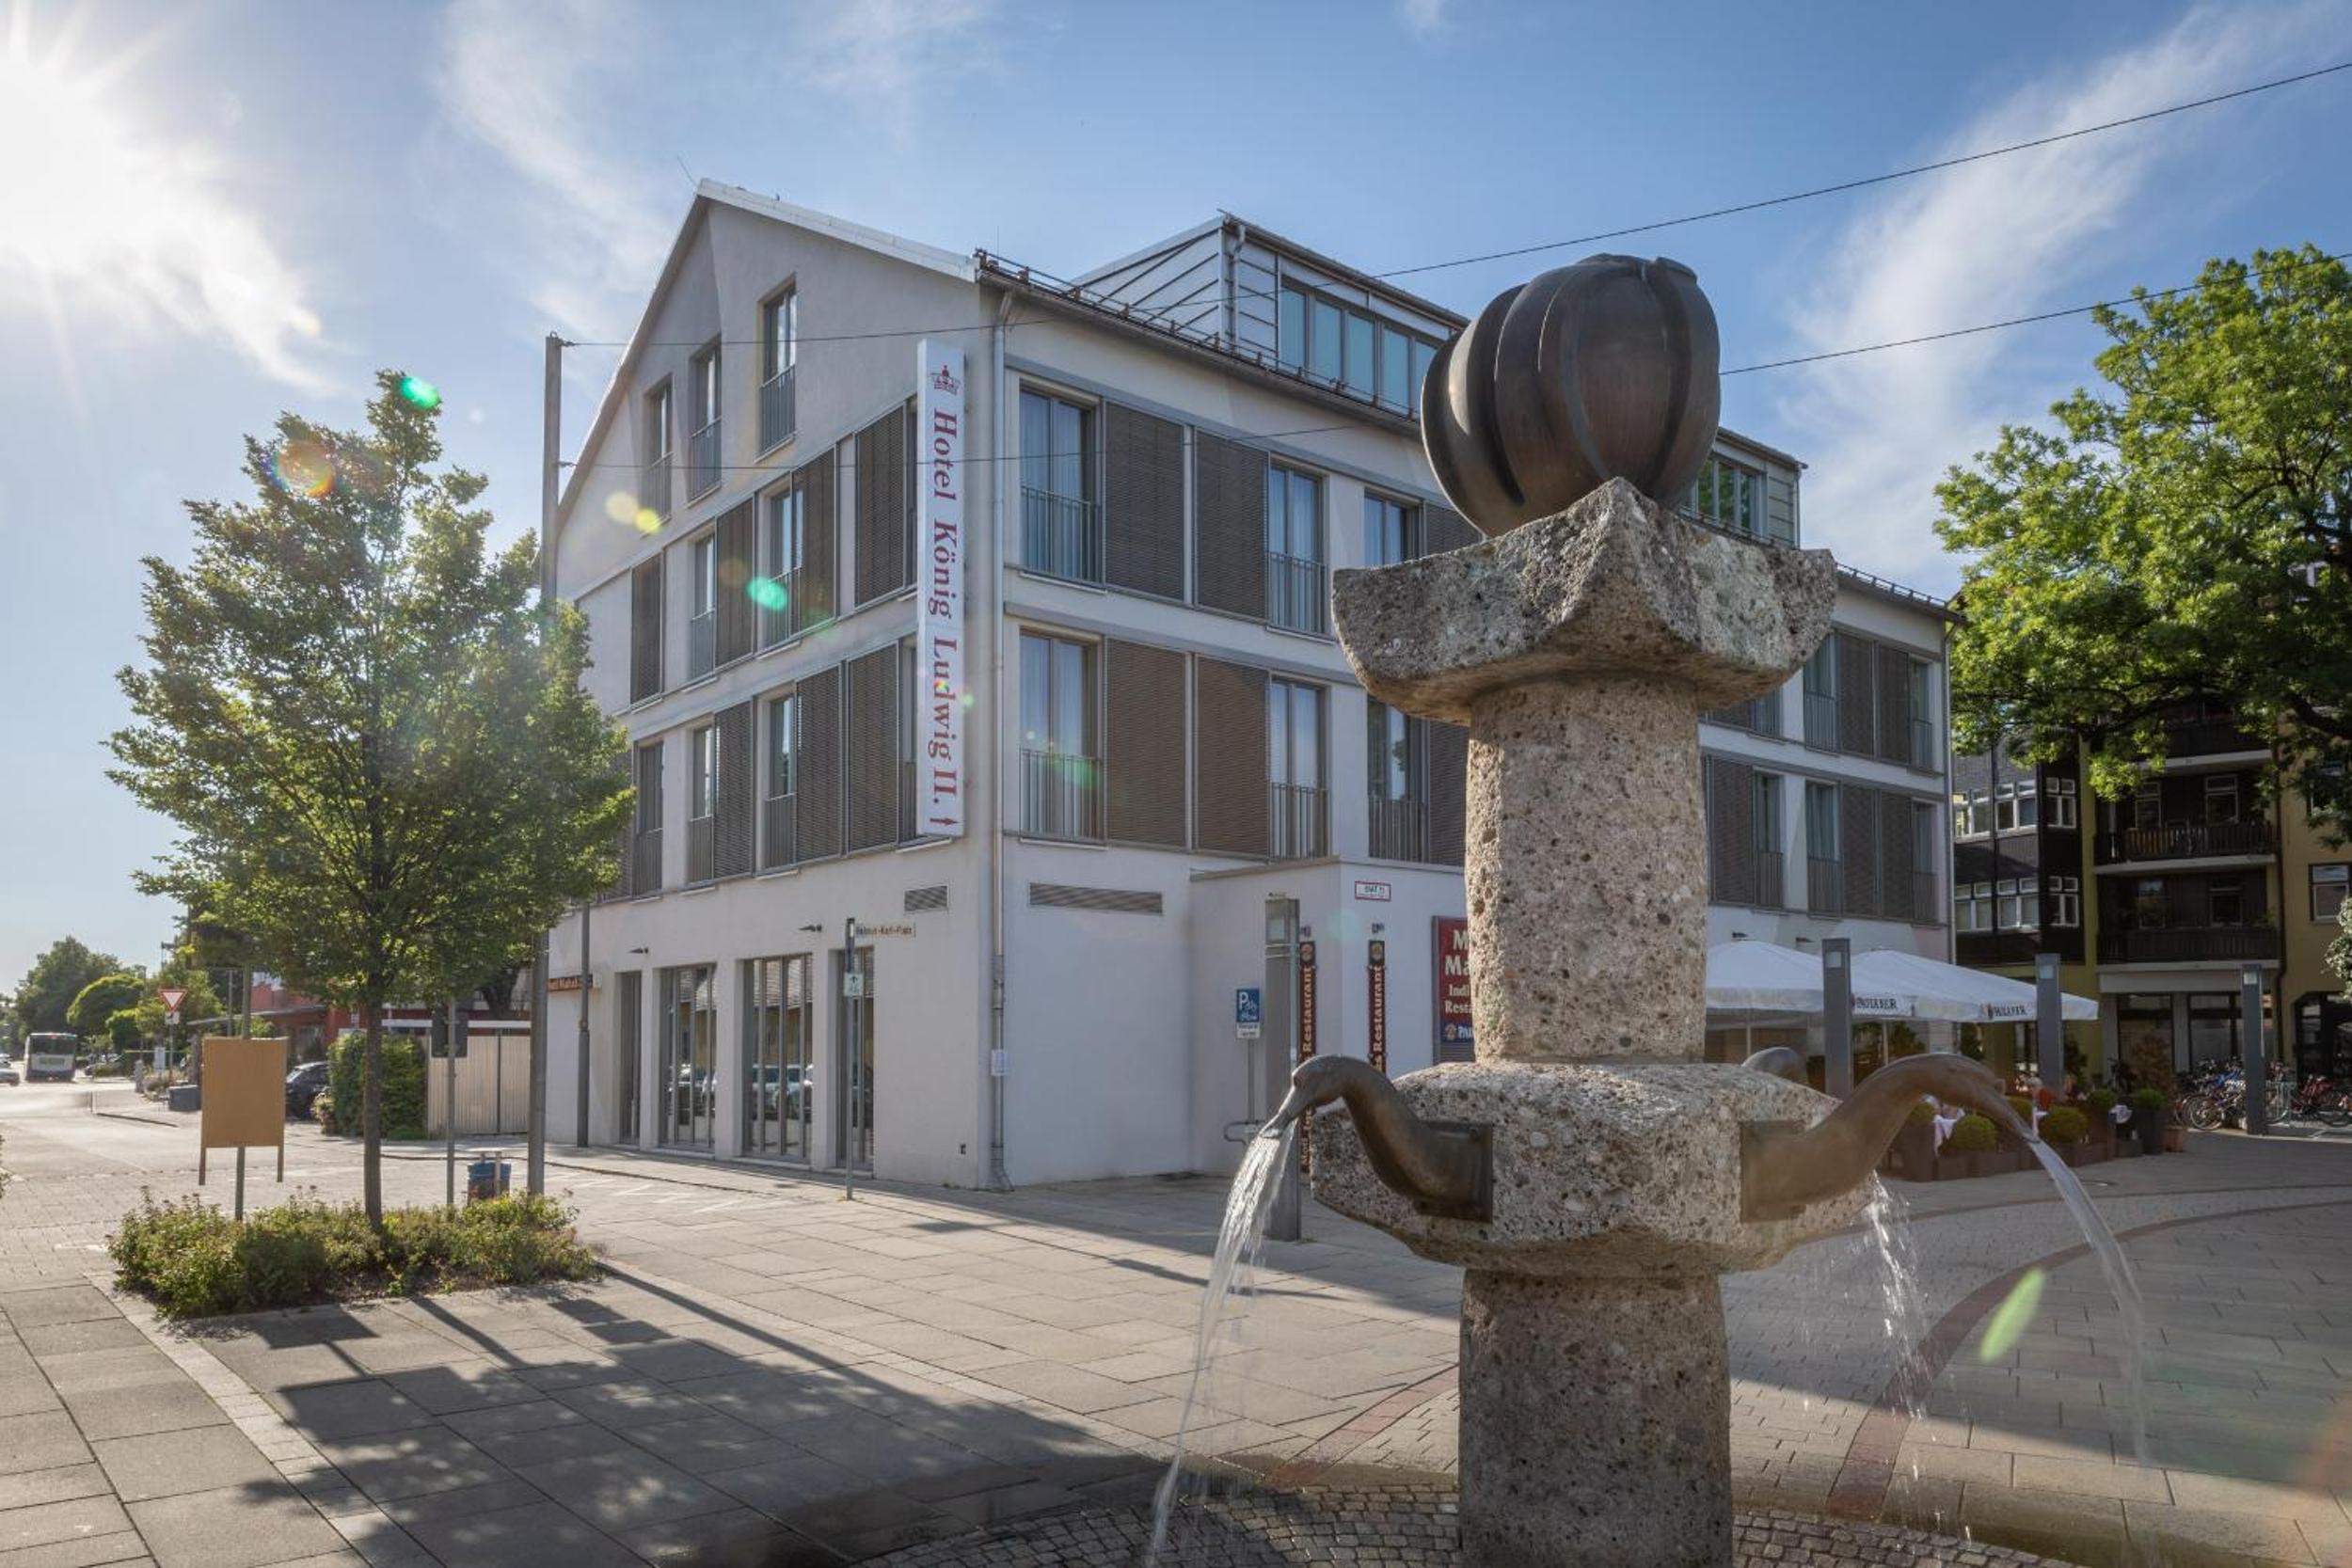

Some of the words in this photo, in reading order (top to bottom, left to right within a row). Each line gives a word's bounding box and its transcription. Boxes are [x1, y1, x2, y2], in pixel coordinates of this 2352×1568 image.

[933, 407, 958, 500] Hotel
[928, 519, 958, 619] König
[928, 636, 958, 761] Ludwig
[1302, 967, 1312, 1053] Restaurant
[1373, 966, 1383, 1052] Restaurant
